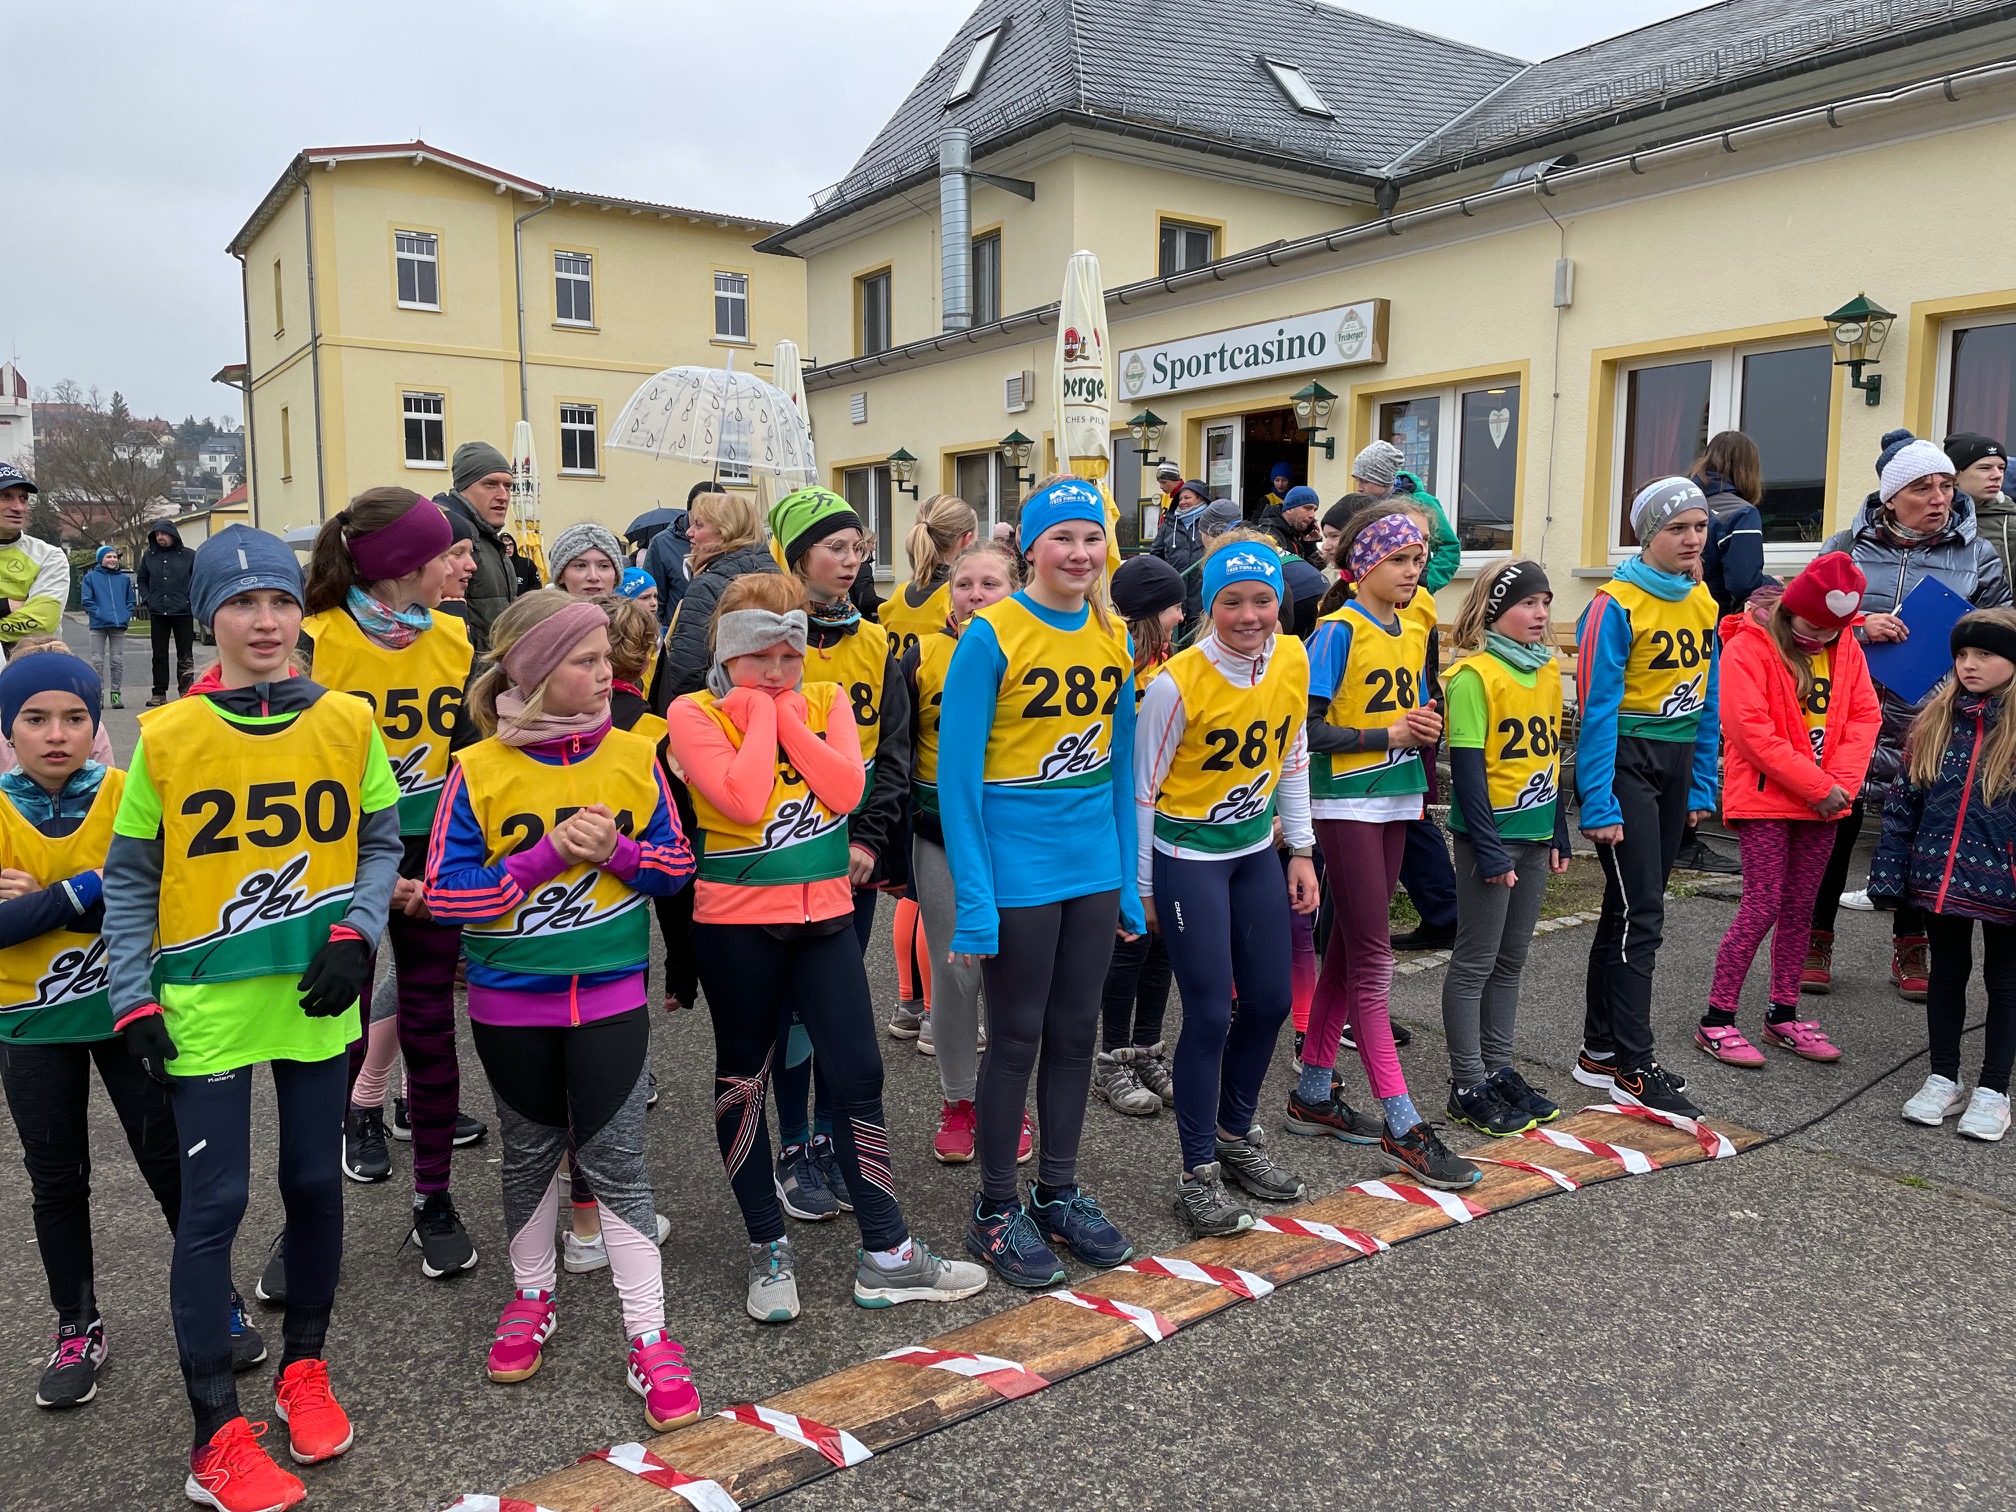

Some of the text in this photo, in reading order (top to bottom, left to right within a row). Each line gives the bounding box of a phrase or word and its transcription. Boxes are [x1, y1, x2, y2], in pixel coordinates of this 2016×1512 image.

[1338, 331, 1364, 342] Freiberger
[1152, 328, 1326, 390] Sportcasino
[1090, 416, 1104, 426] PILS
[1, 619, 38, 632] ONIC
[1022, 665, 1122, 718] 282
[1200, 714, 1292, 772] 281
[181, 779, 351, 859] 250
[1174, 901, 1184, 926] CRAFT
